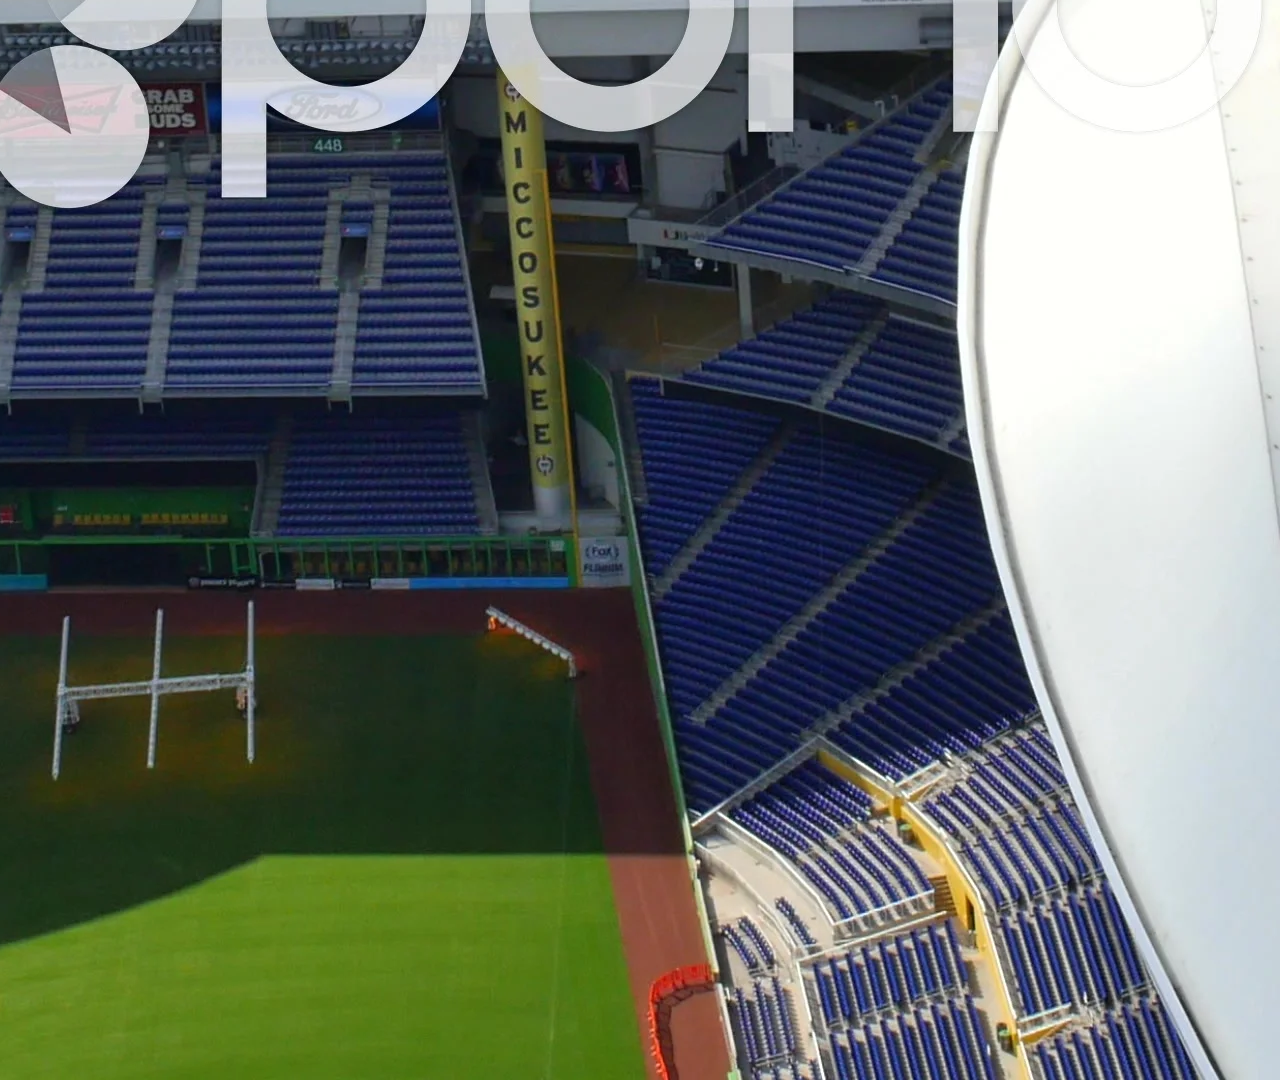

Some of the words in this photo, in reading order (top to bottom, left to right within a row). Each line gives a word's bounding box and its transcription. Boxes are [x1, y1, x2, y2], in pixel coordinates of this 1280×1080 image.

[284, 91, 361, 120] Ford
[313, 138, 344, 153] 448
[504, 110, 553, 447] MICCOSUKEE
